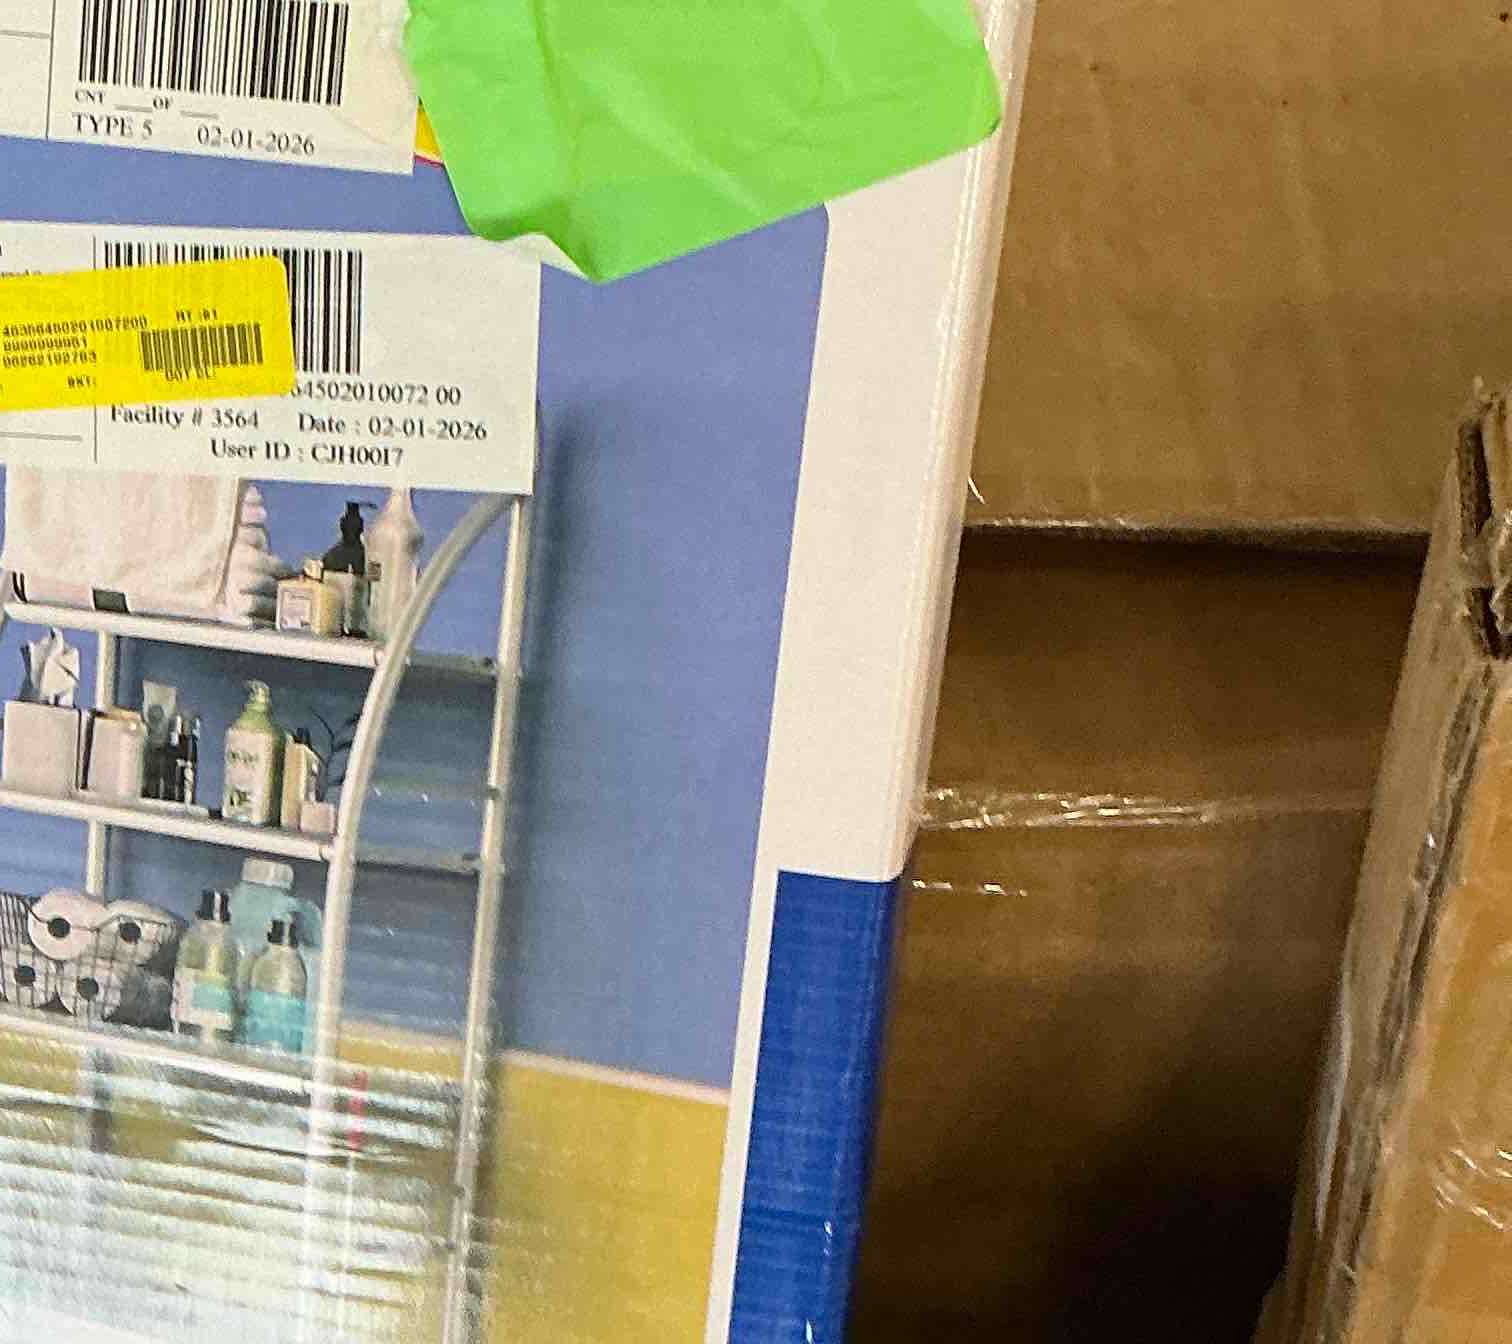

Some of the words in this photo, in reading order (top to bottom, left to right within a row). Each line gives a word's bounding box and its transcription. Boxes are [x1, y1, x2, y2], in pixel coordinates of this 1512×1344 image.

[73, 112, 135, 137] TYPE
[197, 126, 315, 155] 02-01-2026
[292, 380, 428, 406] 4502010072
[436, 386, 461, 405] 00
[110, 404, 183, 427] Facility
[210, 411, 259, 428] 3564
[298, 412, 346, 433] Date
[368, 416, 487, 440] 02-01-2026
[210, 438, 257, 459] User
[263, 440, 291, 460] ID
